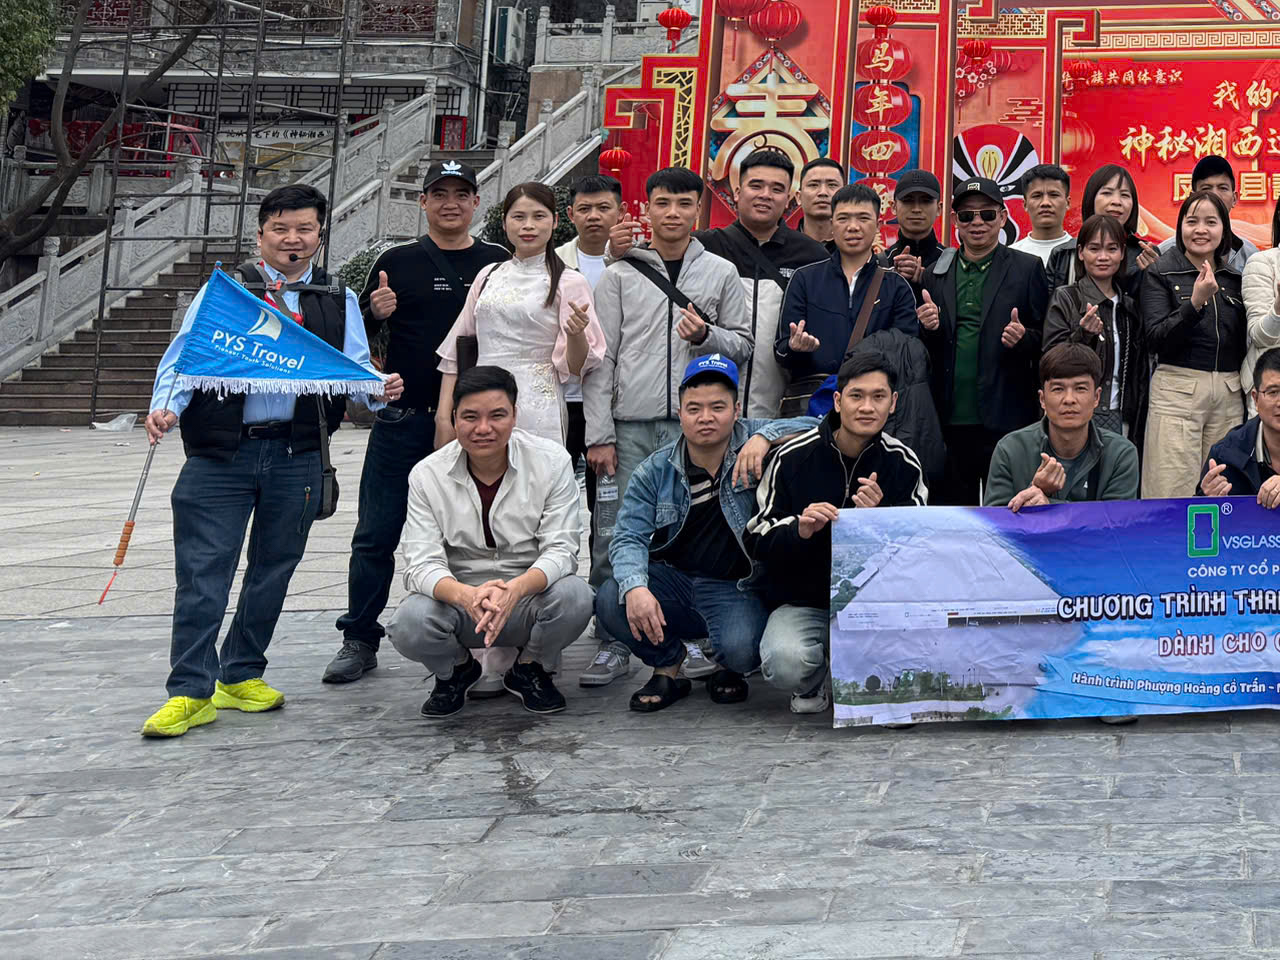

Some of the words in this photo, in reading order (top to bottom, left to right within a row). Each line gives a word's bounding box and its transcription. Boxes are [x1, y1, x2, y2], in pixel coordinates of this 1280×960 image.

[211, 329, 246, 351] PYS
[250, 341, 305, 370] Travel
[1187, 564, 1228, 578] CÔNG
[1230, 565, 1245, 576] TY
[1248, 558, 1269, 575] CỔ
[1057, 592, 1154, 622] CHƯƠNG
[1160, 584, 1226, 618] TRÌNH
[1158, 629, 1214, 657] DÀNH
[1222, 632, 1266, 653] CHO
[1071, 672, 1102, 687] Hành
[1105, 674, 1134, 690] trình
[1137, 679, 1181, 695] Phượng
[1184, 682, 1220, 695] Hoàng
[1239, 677, 1266, 693] Trấn
